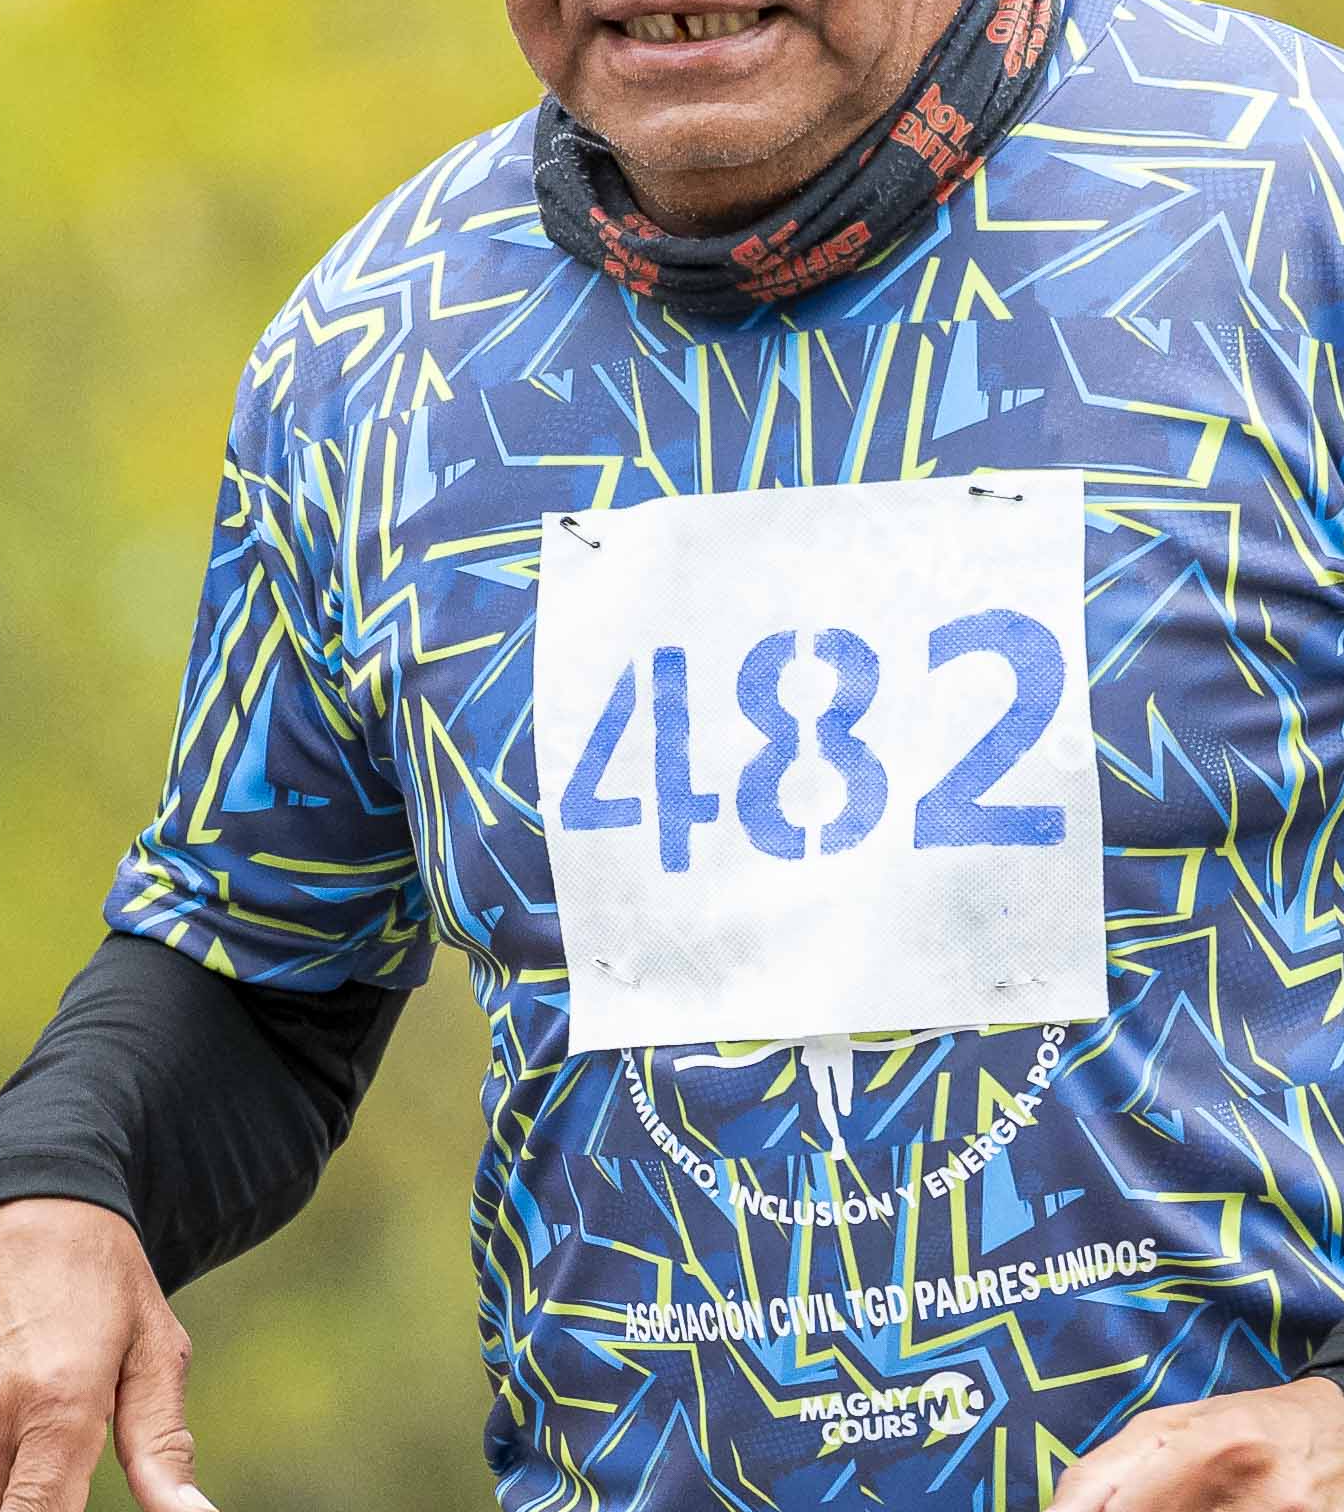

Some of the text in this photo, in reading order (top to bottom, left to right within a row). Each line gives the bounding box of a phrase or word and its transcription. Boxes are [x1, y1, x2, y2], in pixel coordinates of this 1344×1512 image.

[915, 82, 982, 168] ROY
[560, 607, 1067, 874] 482
[728, 1181, 895, 1227] INCLUSIÓN
[895, 1181, 917, 1209] Y
[922, 1092, 1042, 1200] ENERGÍA
[1026, 1020, 1071, 1090] POS
[624, 1237, 1158, 1343] ASOCIACIÓN CIVIL TGD PADRES UNIDOS
[799, 1385, 913, 1422] MAGNY
[821, 1411, 918, 1445] COURS
